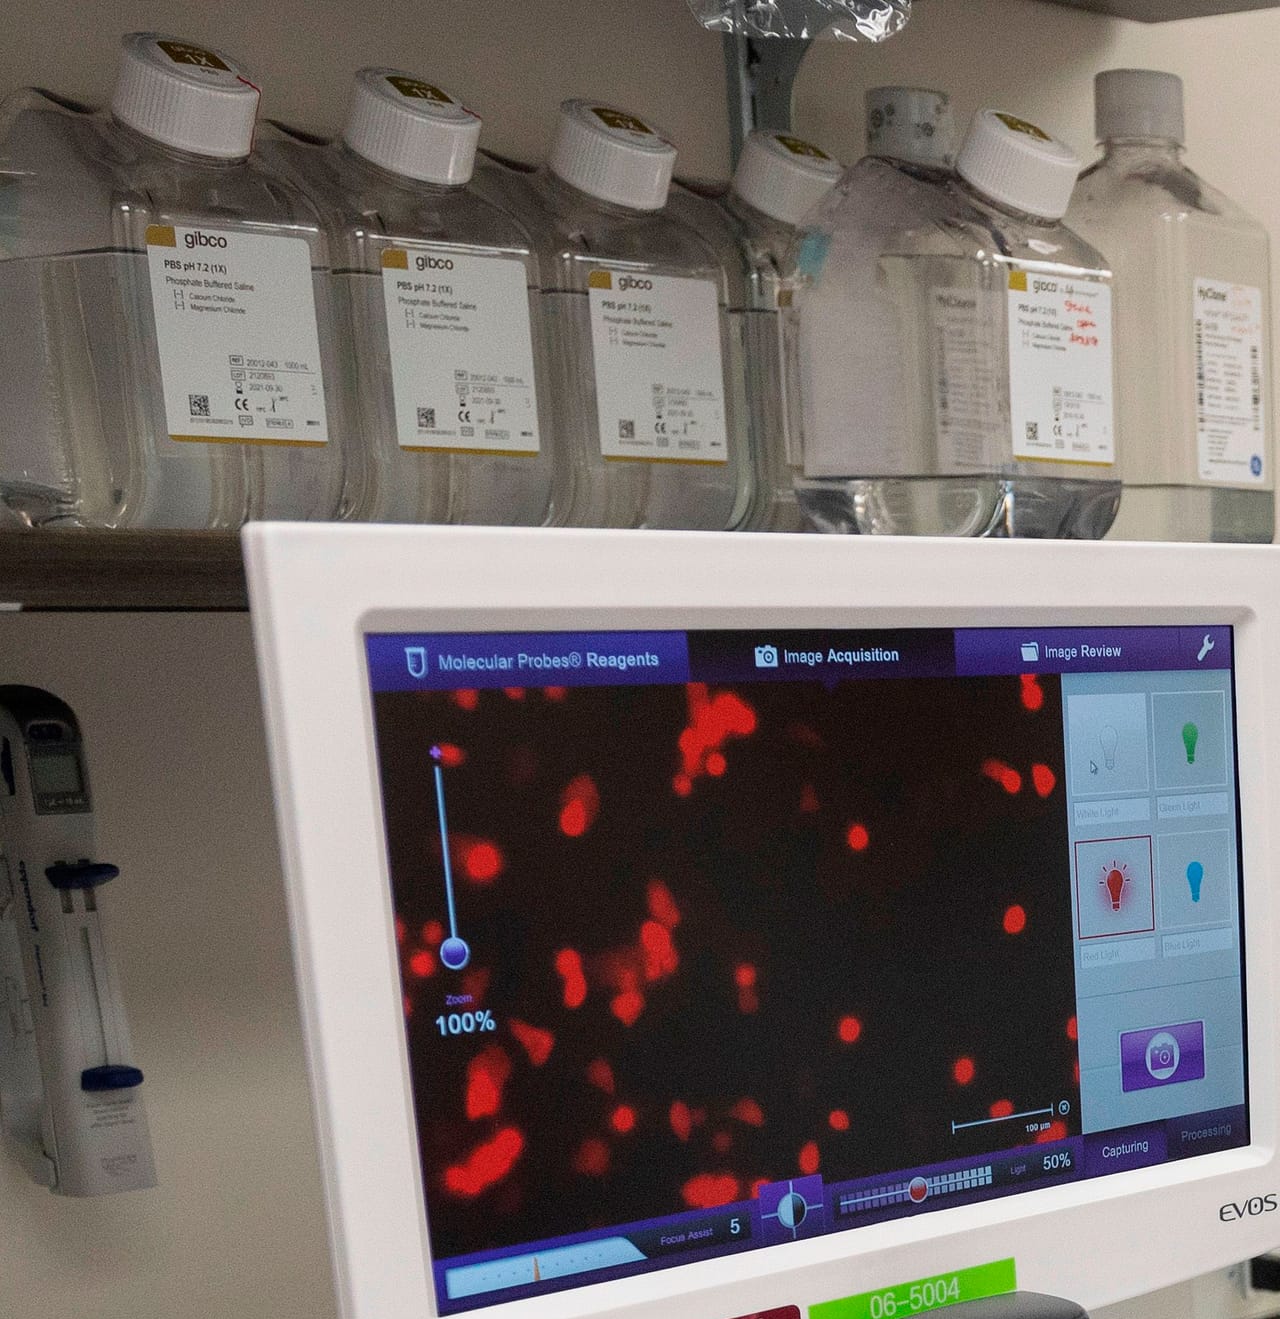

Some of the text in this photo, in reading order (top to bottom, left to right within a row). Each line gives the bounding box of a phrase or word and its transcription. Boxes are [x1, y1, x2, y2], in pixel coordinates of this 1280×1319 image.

[184, 231, 228, 249] gibco
[164, 259, 227, 275] PBS pH 7.2 (1X)
[415, 256, 454, 271] gibco
[165, 276, 203, 287] Phosphate
[204, 279, 233, 290] Buffered
[617, 275, 653, 291] gibco
[438, 654, 513, 671] Molecular
[587, 652, 660, 670] Reagents
[784, 648, 900, 666] Image Acquisition
[1045, 645, 1122, 660] Image Review
[445, 993, 473, 1006] Zoom
[435, 1009, 496, 1036] 100%
[1025, 1122, 1039, 1133] 100
[1181, 1122, 1233, 1143] Processing
[1102, 1140, 1149, 1159] Capturing
[1010, 1152, 1072, 1176] Light 50%
[1219, 1193, 1278, 1222] EVOS
[660, 1218, 741, 1246] Focus Assist 5
[870, 1276, 961, 1319] 06-5004
